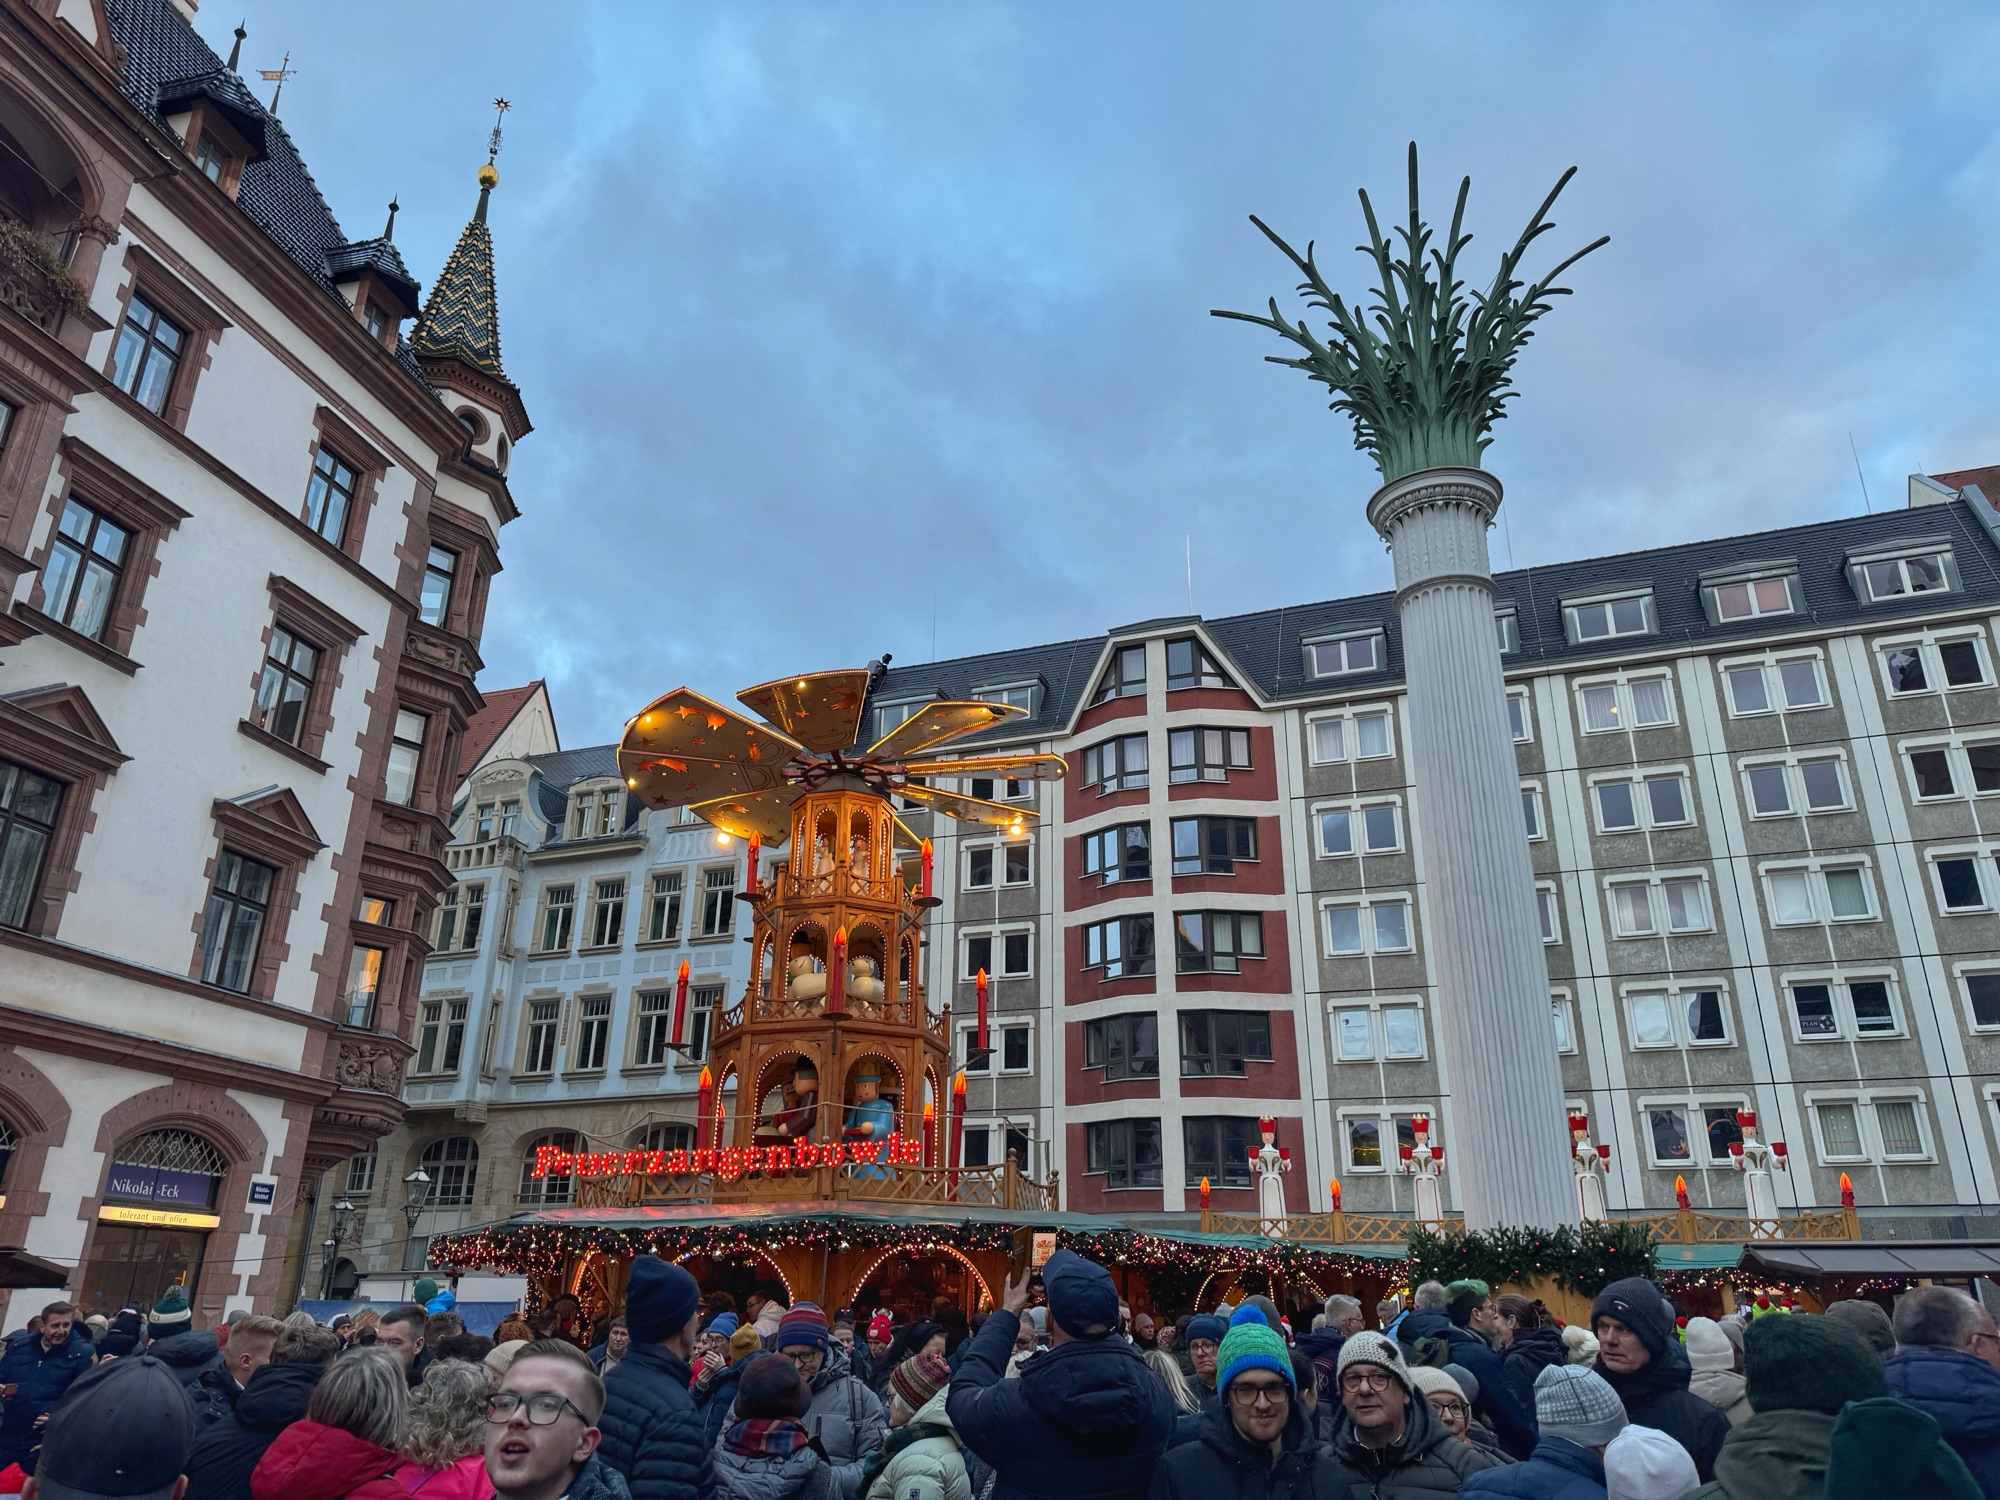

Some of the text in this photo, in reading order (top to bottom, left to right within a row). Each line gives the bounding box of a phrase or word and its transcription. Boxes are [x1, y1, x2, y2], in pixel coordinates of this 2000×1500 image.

[530, 1131, 922, 1180] Feuerzangenbowle
[119, 1210, 188, 1224] tolerant und offen
